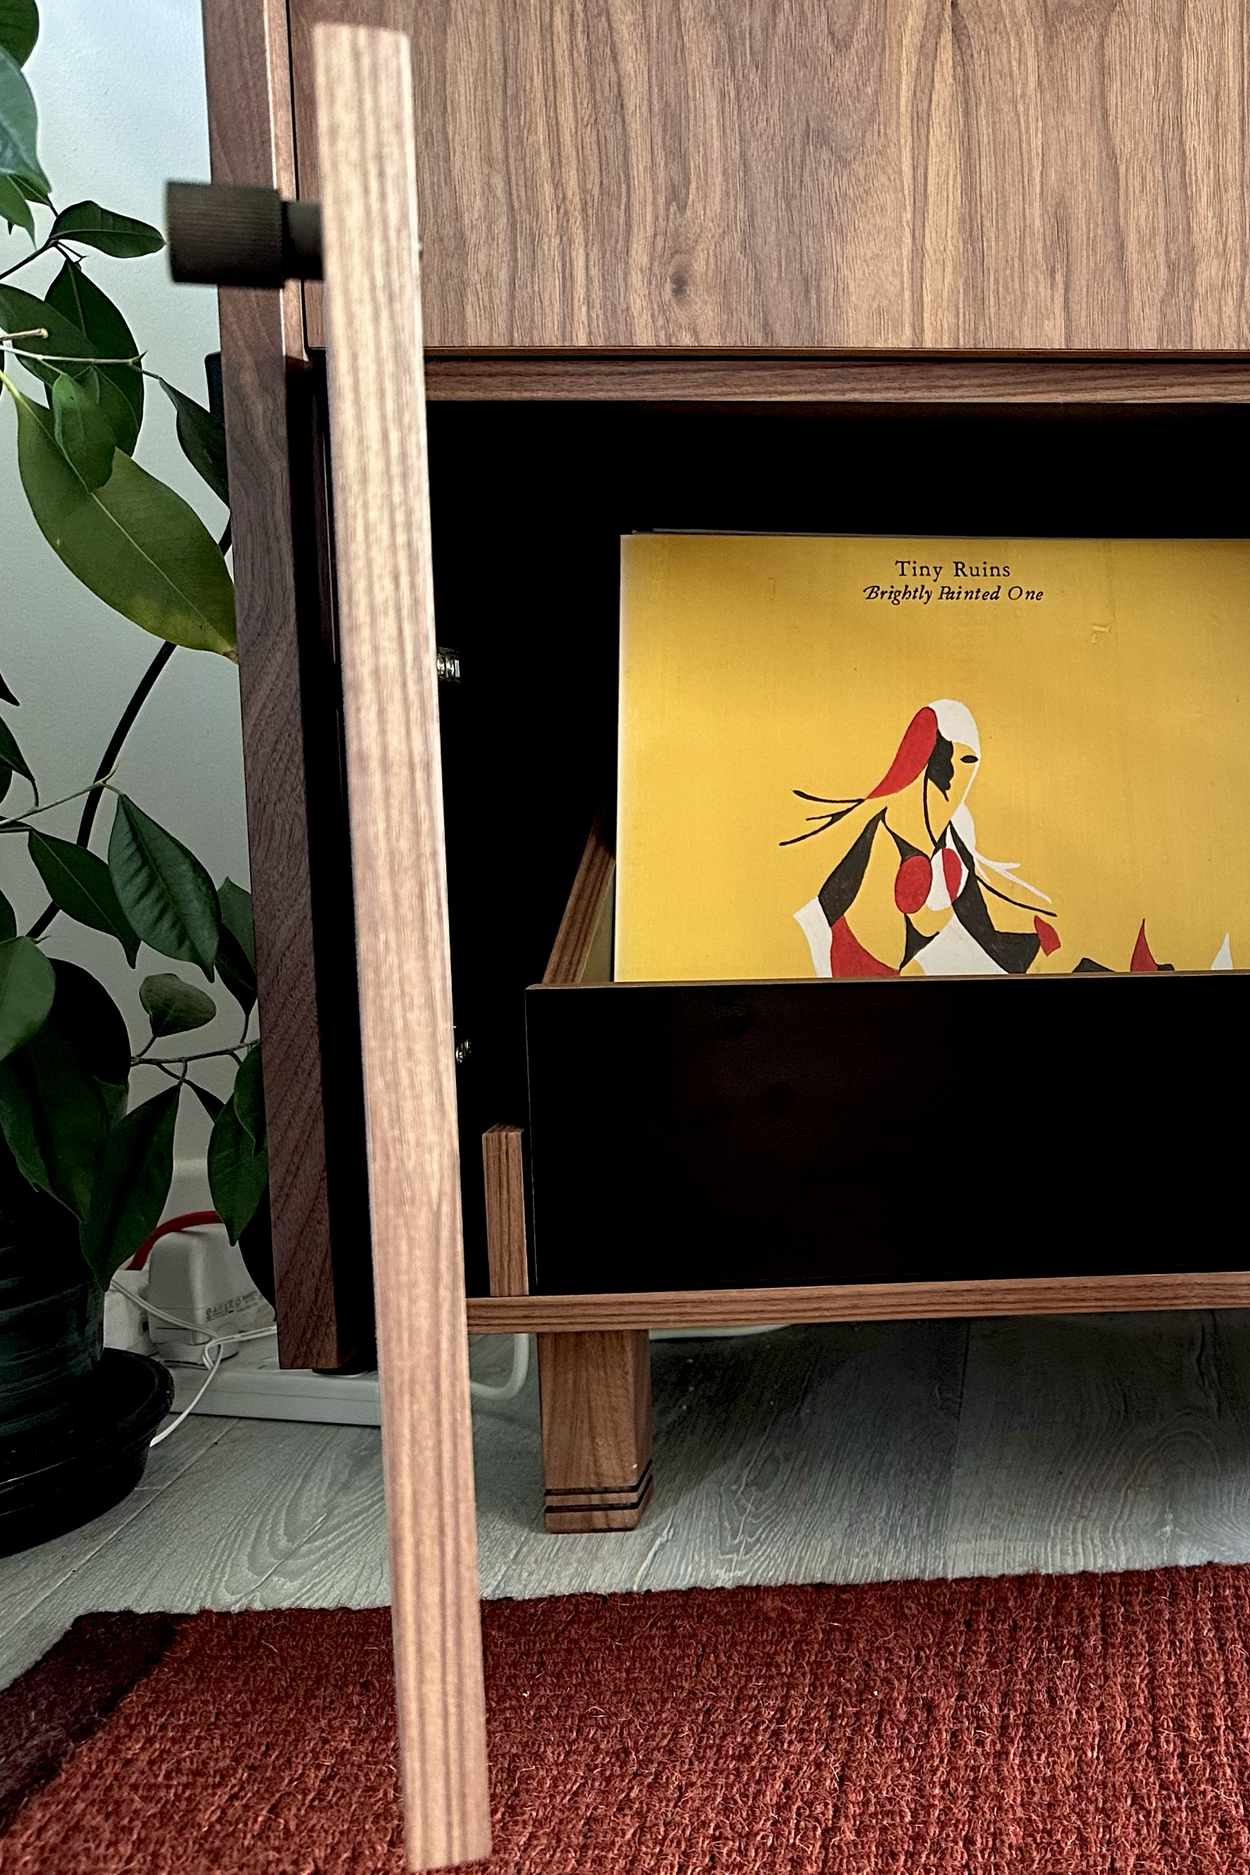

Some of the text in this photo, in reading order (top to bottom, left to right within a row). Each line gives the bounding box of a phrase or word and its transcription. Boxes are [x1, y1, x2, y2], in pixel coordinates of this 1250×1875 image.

[894, 560, 1011, 582] Tiny Ruins
[862, 585, 1044, 605] Brightly Painted One
